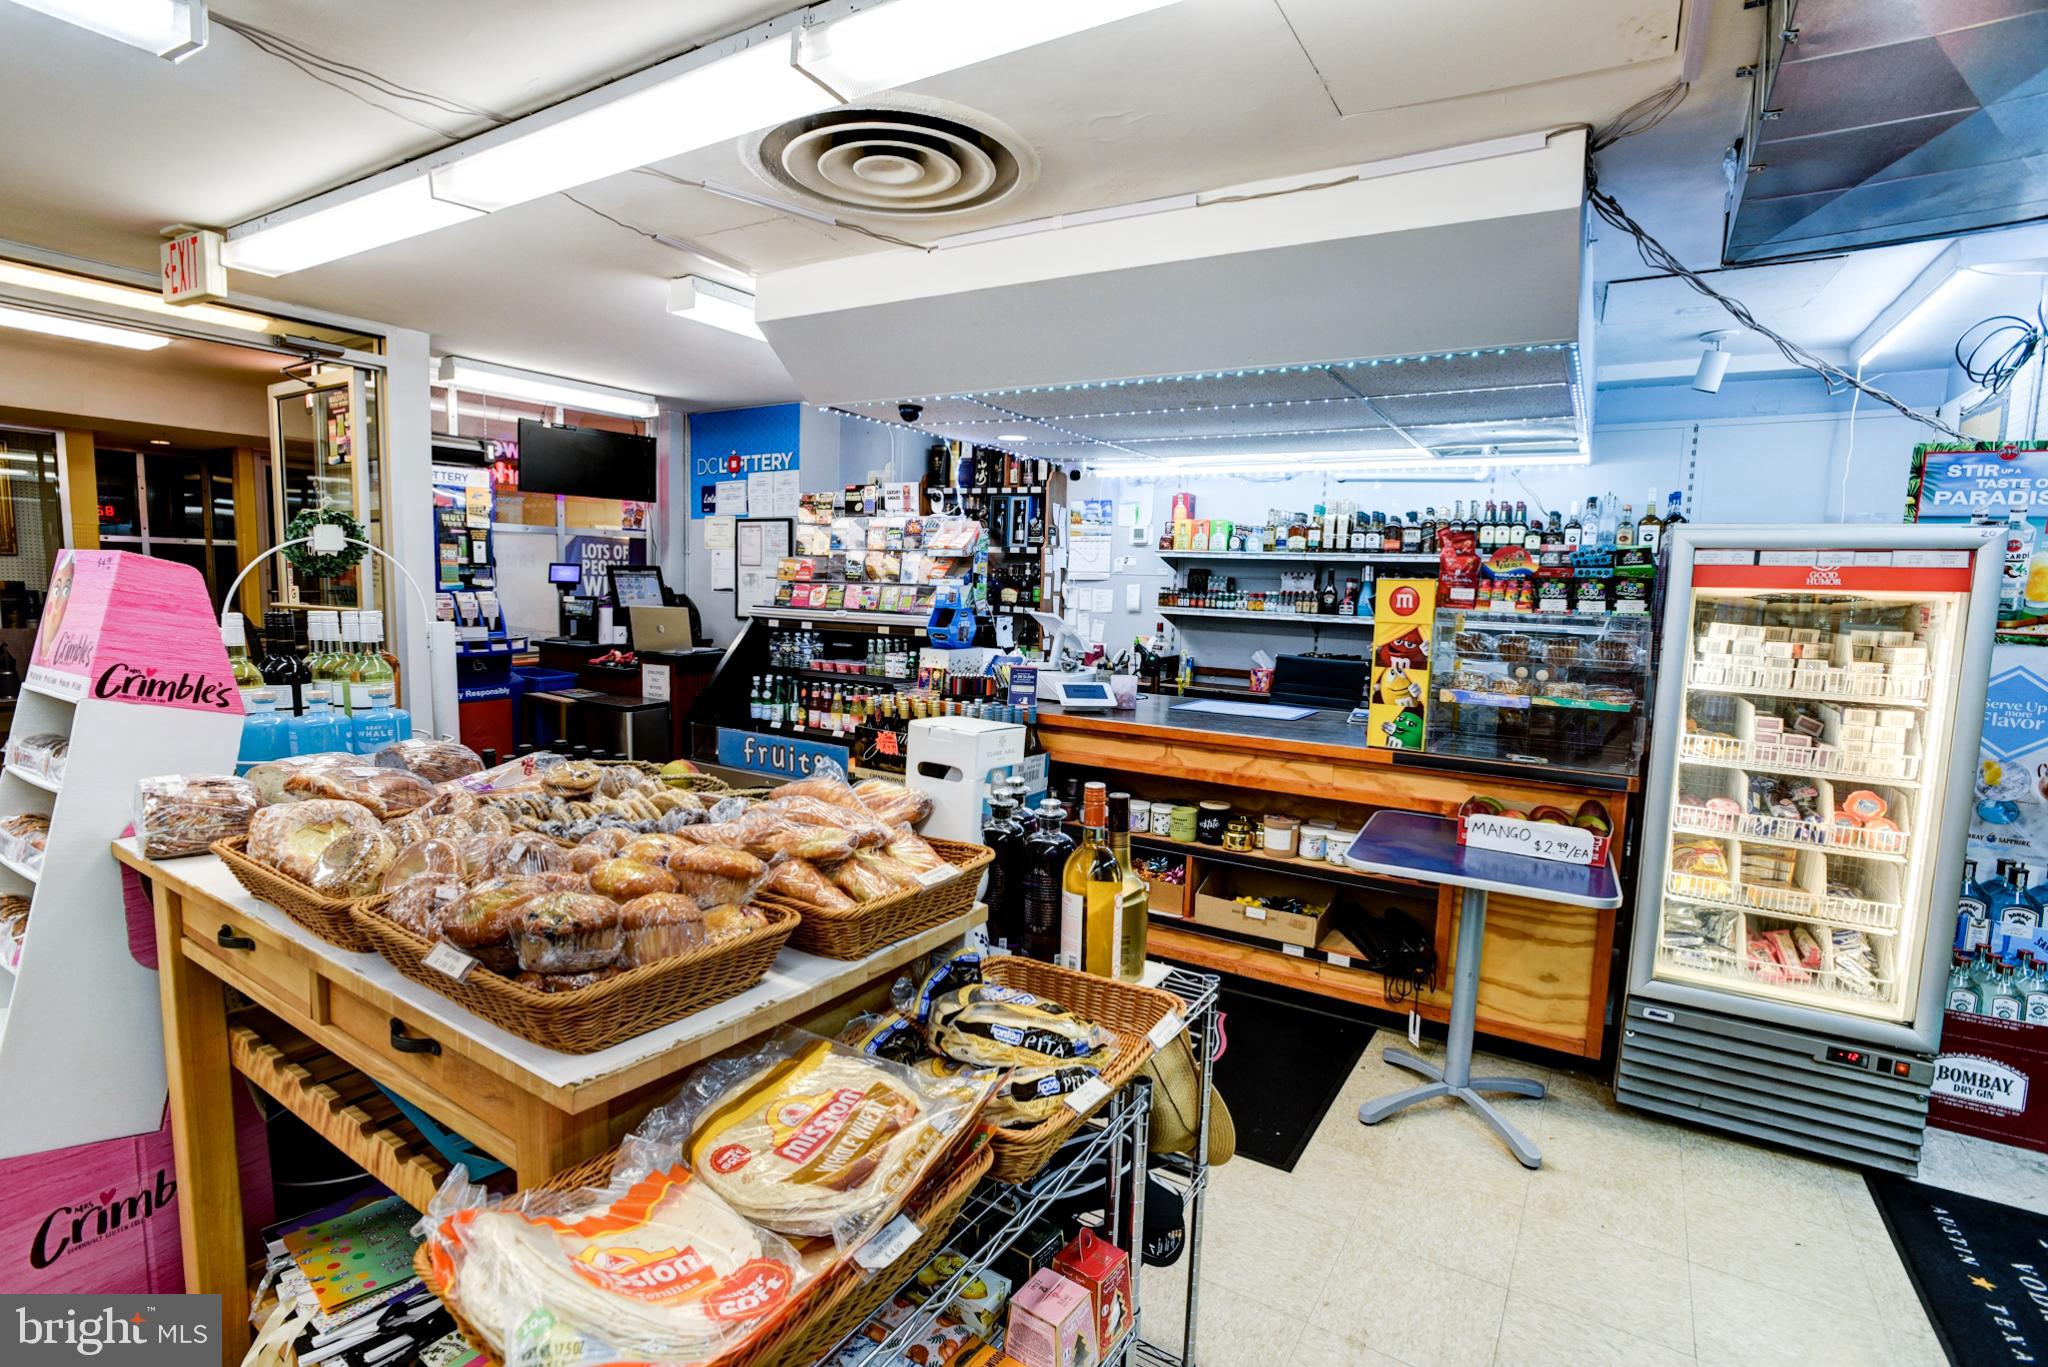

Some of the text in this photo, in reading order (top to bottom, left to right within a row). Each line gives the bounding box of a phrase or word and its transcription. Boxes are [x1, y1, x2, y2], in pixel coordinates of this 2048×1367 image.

[169, 236, 198, 295] EXIT
[432, 471, 469, 481] TTERY
[1946, 464, 2000, 478] STIR
[1975, 478, 2048, 489] TASTE O
[1933, 490, 2048, 506] PARADIS
[581, 543, 630, 560] LOTS OF
[583, 576, 609, 597] WI
[1806, 578, 1842, 586] HUMOR
[95, 663, 233, 708] Crimble's
[465, 687, 511, 699] Responsibly
[2004, 710, 2033, 719] more
[2025, 701, 2048, 716] Up
[357, 730, 394, 738] WHALE
[869, 773, 906, 783] CHARDONNA
[1471, 822, 1532, 841] MANGO
[1997, 836, 2031, 848] SAPPHIRE
[1024, 1035, 1065, 1058] PITA
[1936, 1065, 2014, 1097] BOMBAY
[1953, 1084, 1995, 1100] DRY GIN
[814, 1136, 864, 1173] WHOLE
[853, 1100, 891, 1140] WHEAT
[74, 1201, 94, 1215] MRS
[1930, 1204, 1982, 1268] AUSTIN
